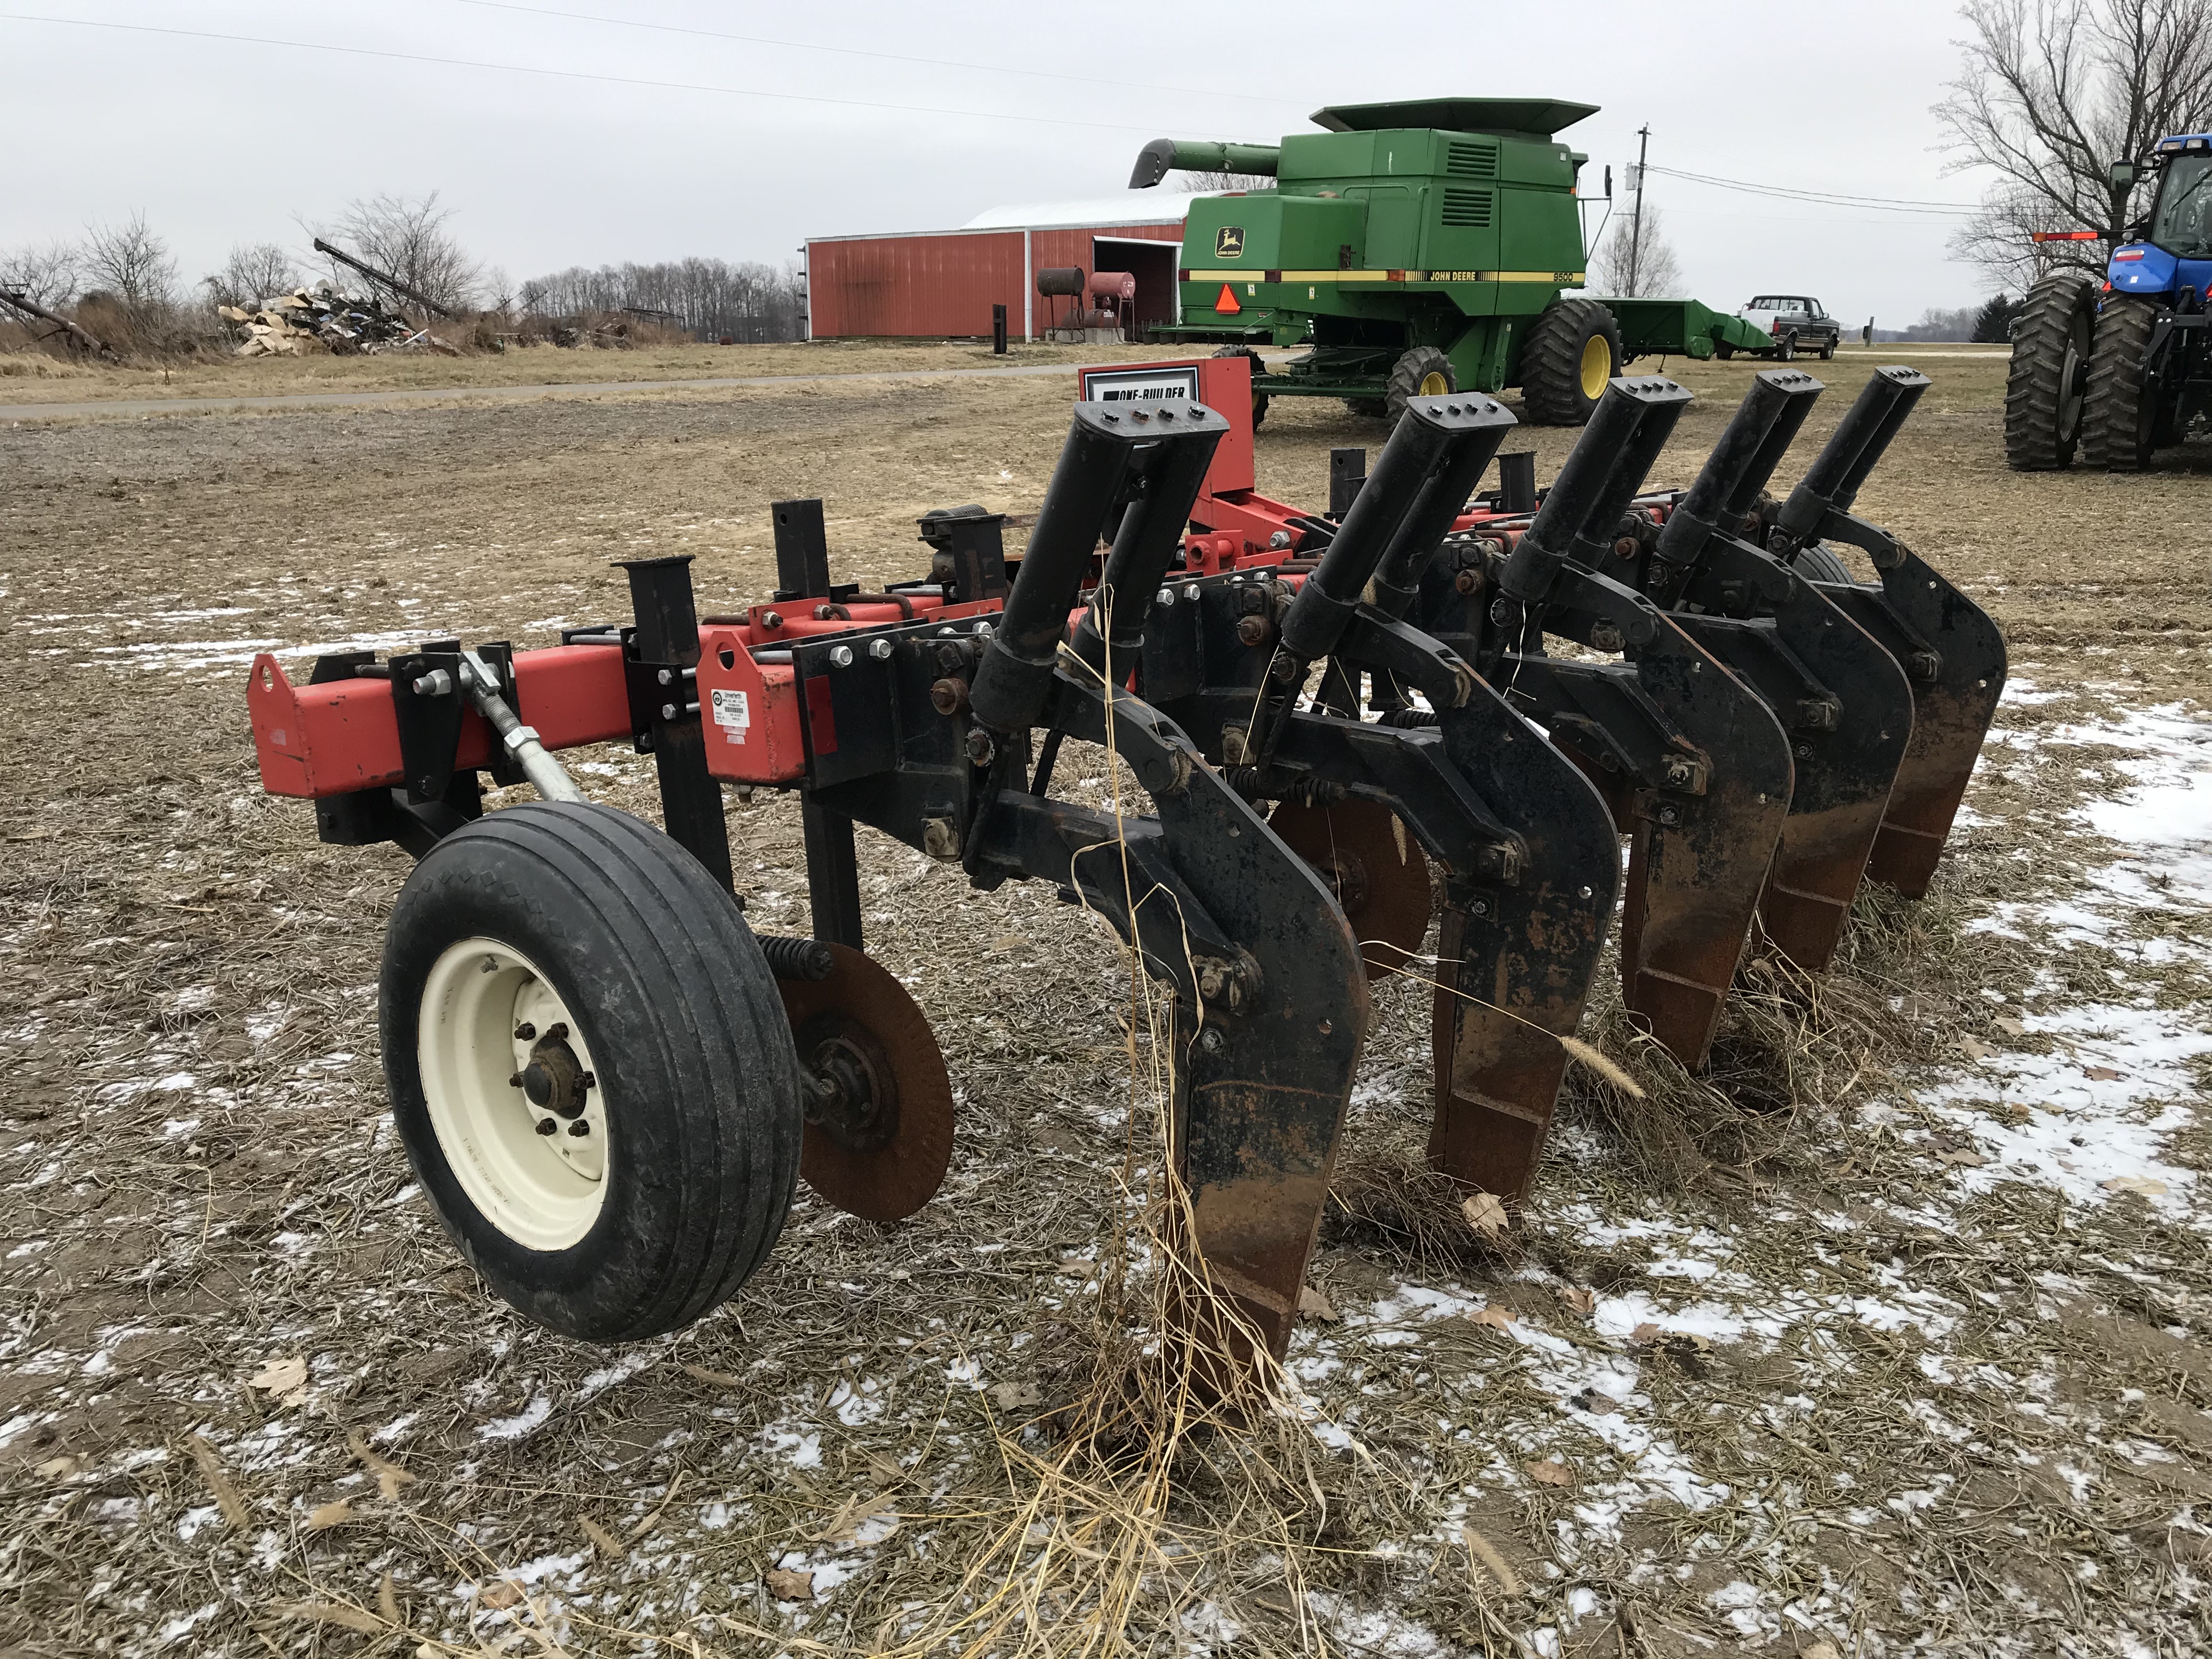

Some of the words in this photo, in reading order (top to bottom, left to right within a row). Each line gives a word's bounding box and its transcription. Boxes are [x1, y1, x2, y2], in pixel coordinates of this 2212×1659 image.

[1430, 271, 1450, 281] JOHN
[1452, 271, 1476, 281] DEERE
[1553, 273, 1573, 281] 9500
